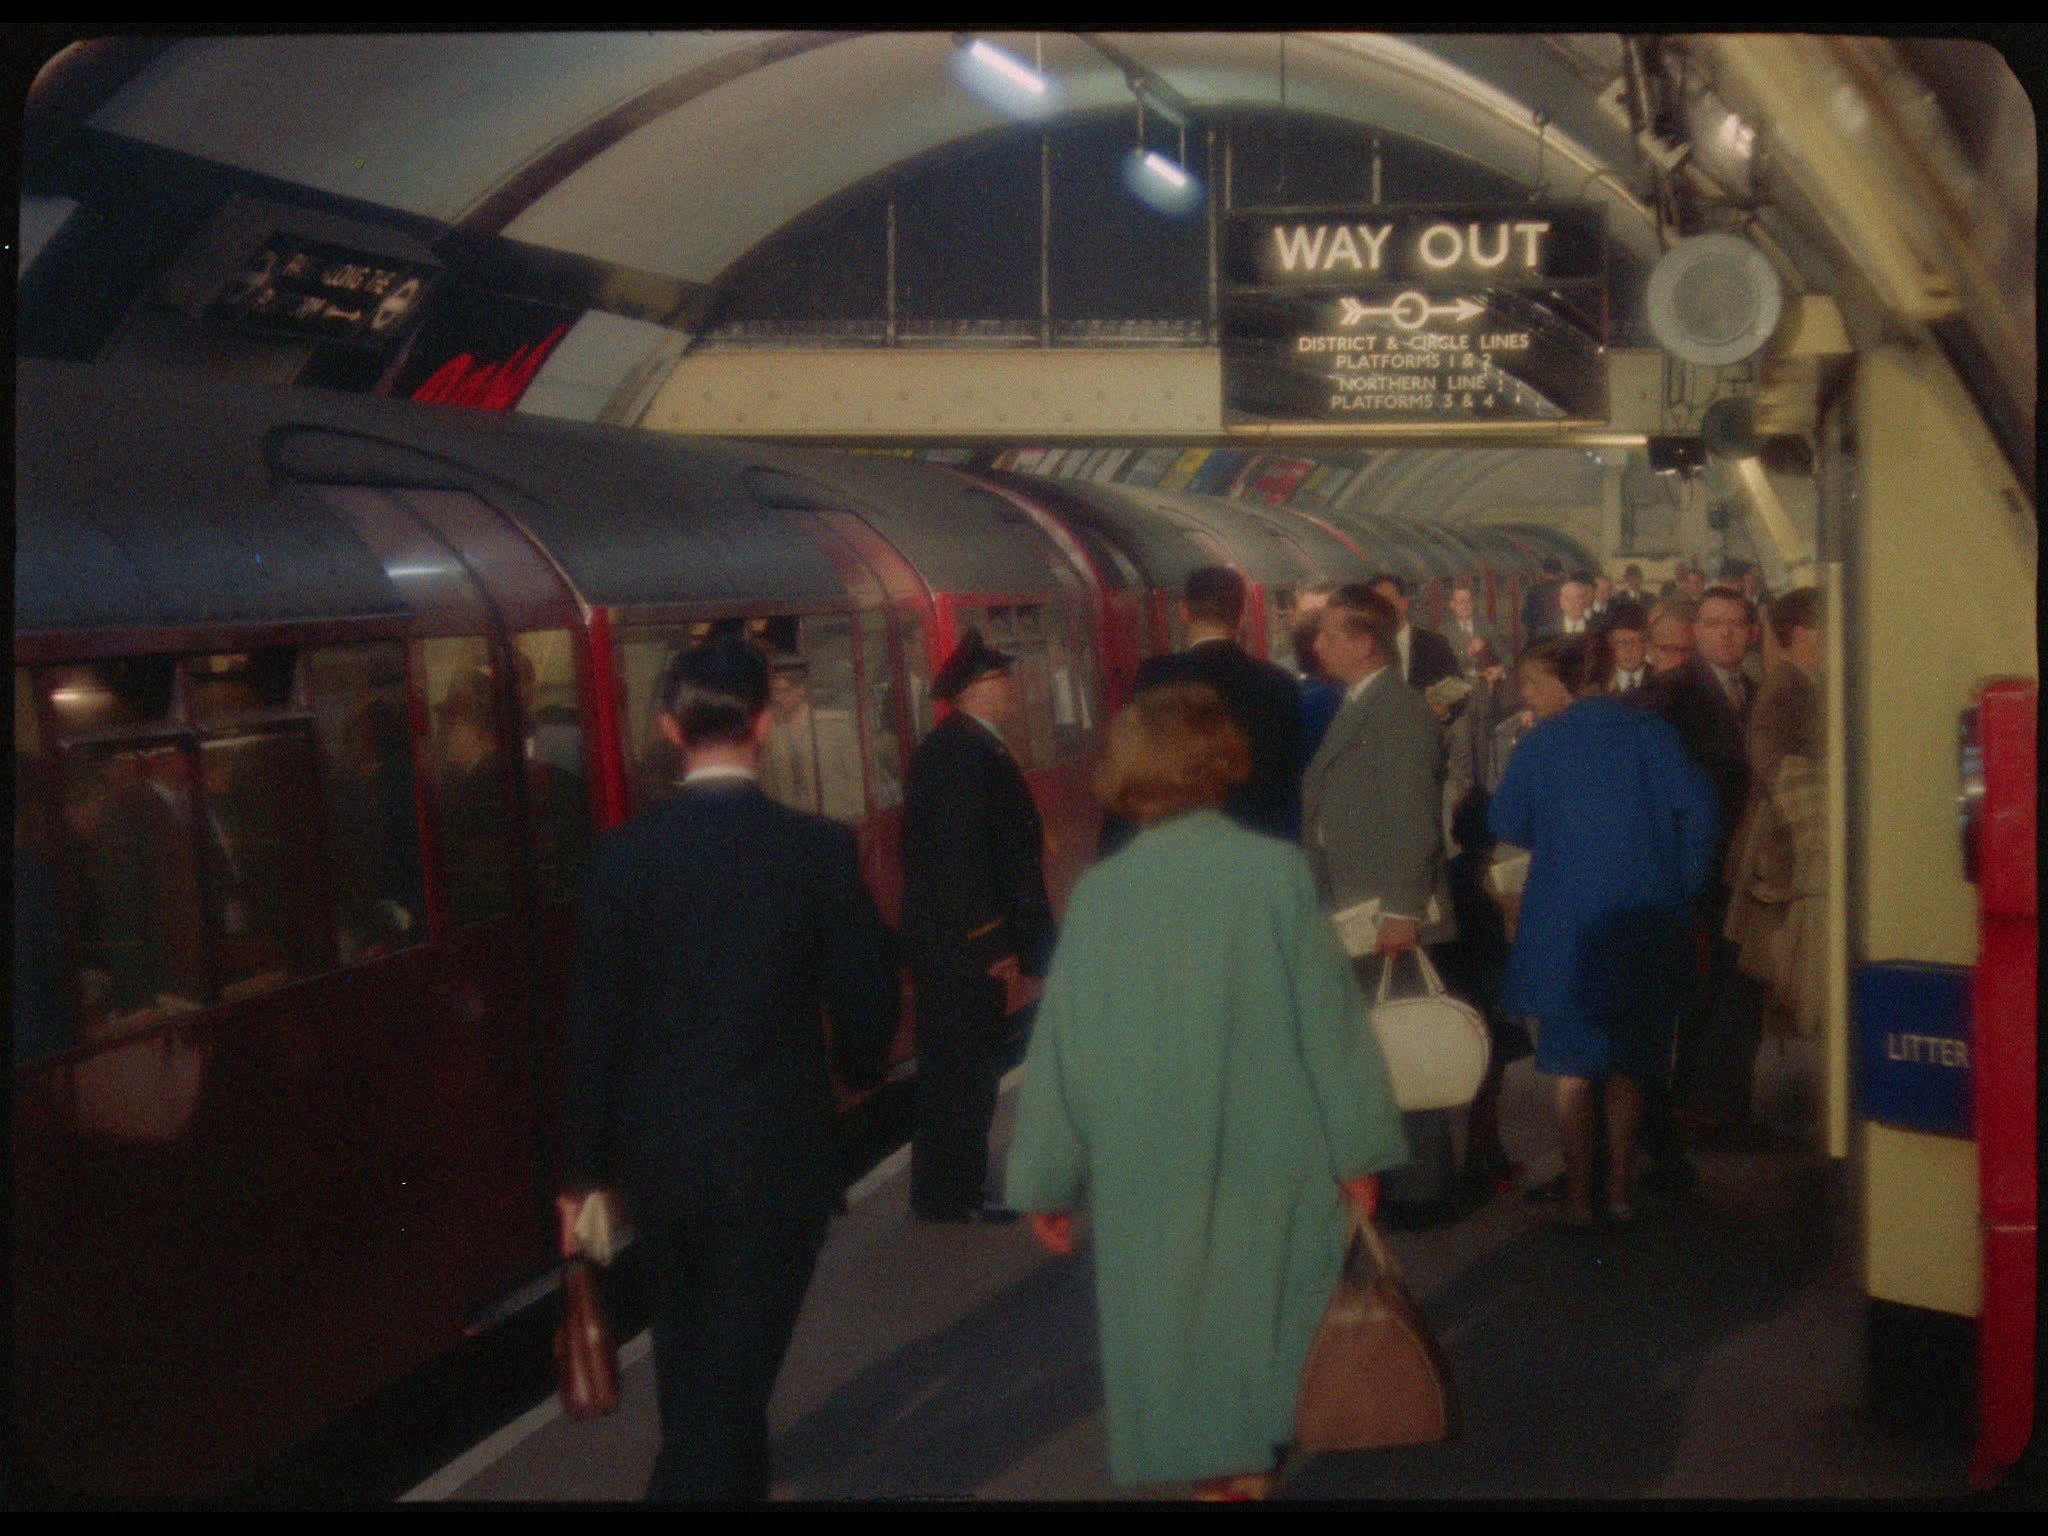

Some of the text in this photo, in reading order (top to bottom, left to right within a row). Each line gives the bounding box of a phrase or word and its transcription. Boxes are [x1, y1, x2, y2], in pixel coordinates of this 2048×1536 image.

[1274, 222, 1551, 271] WAY OUT
[1298, 334, 1530, 352] DISTRICT & CIRCLE LINES
[1335, 354, 1440, 369] PLATFORMS
[1462, 354, 1474, 368] &
[1483, 353, 1492, 368] 2
[1338, 375, 1487, 391] NORTHERN LINE
[1331, 393, 1494, 409] PLATFORMS 3 & 4
[1888, 1032, 1970, 1068] LITTER
